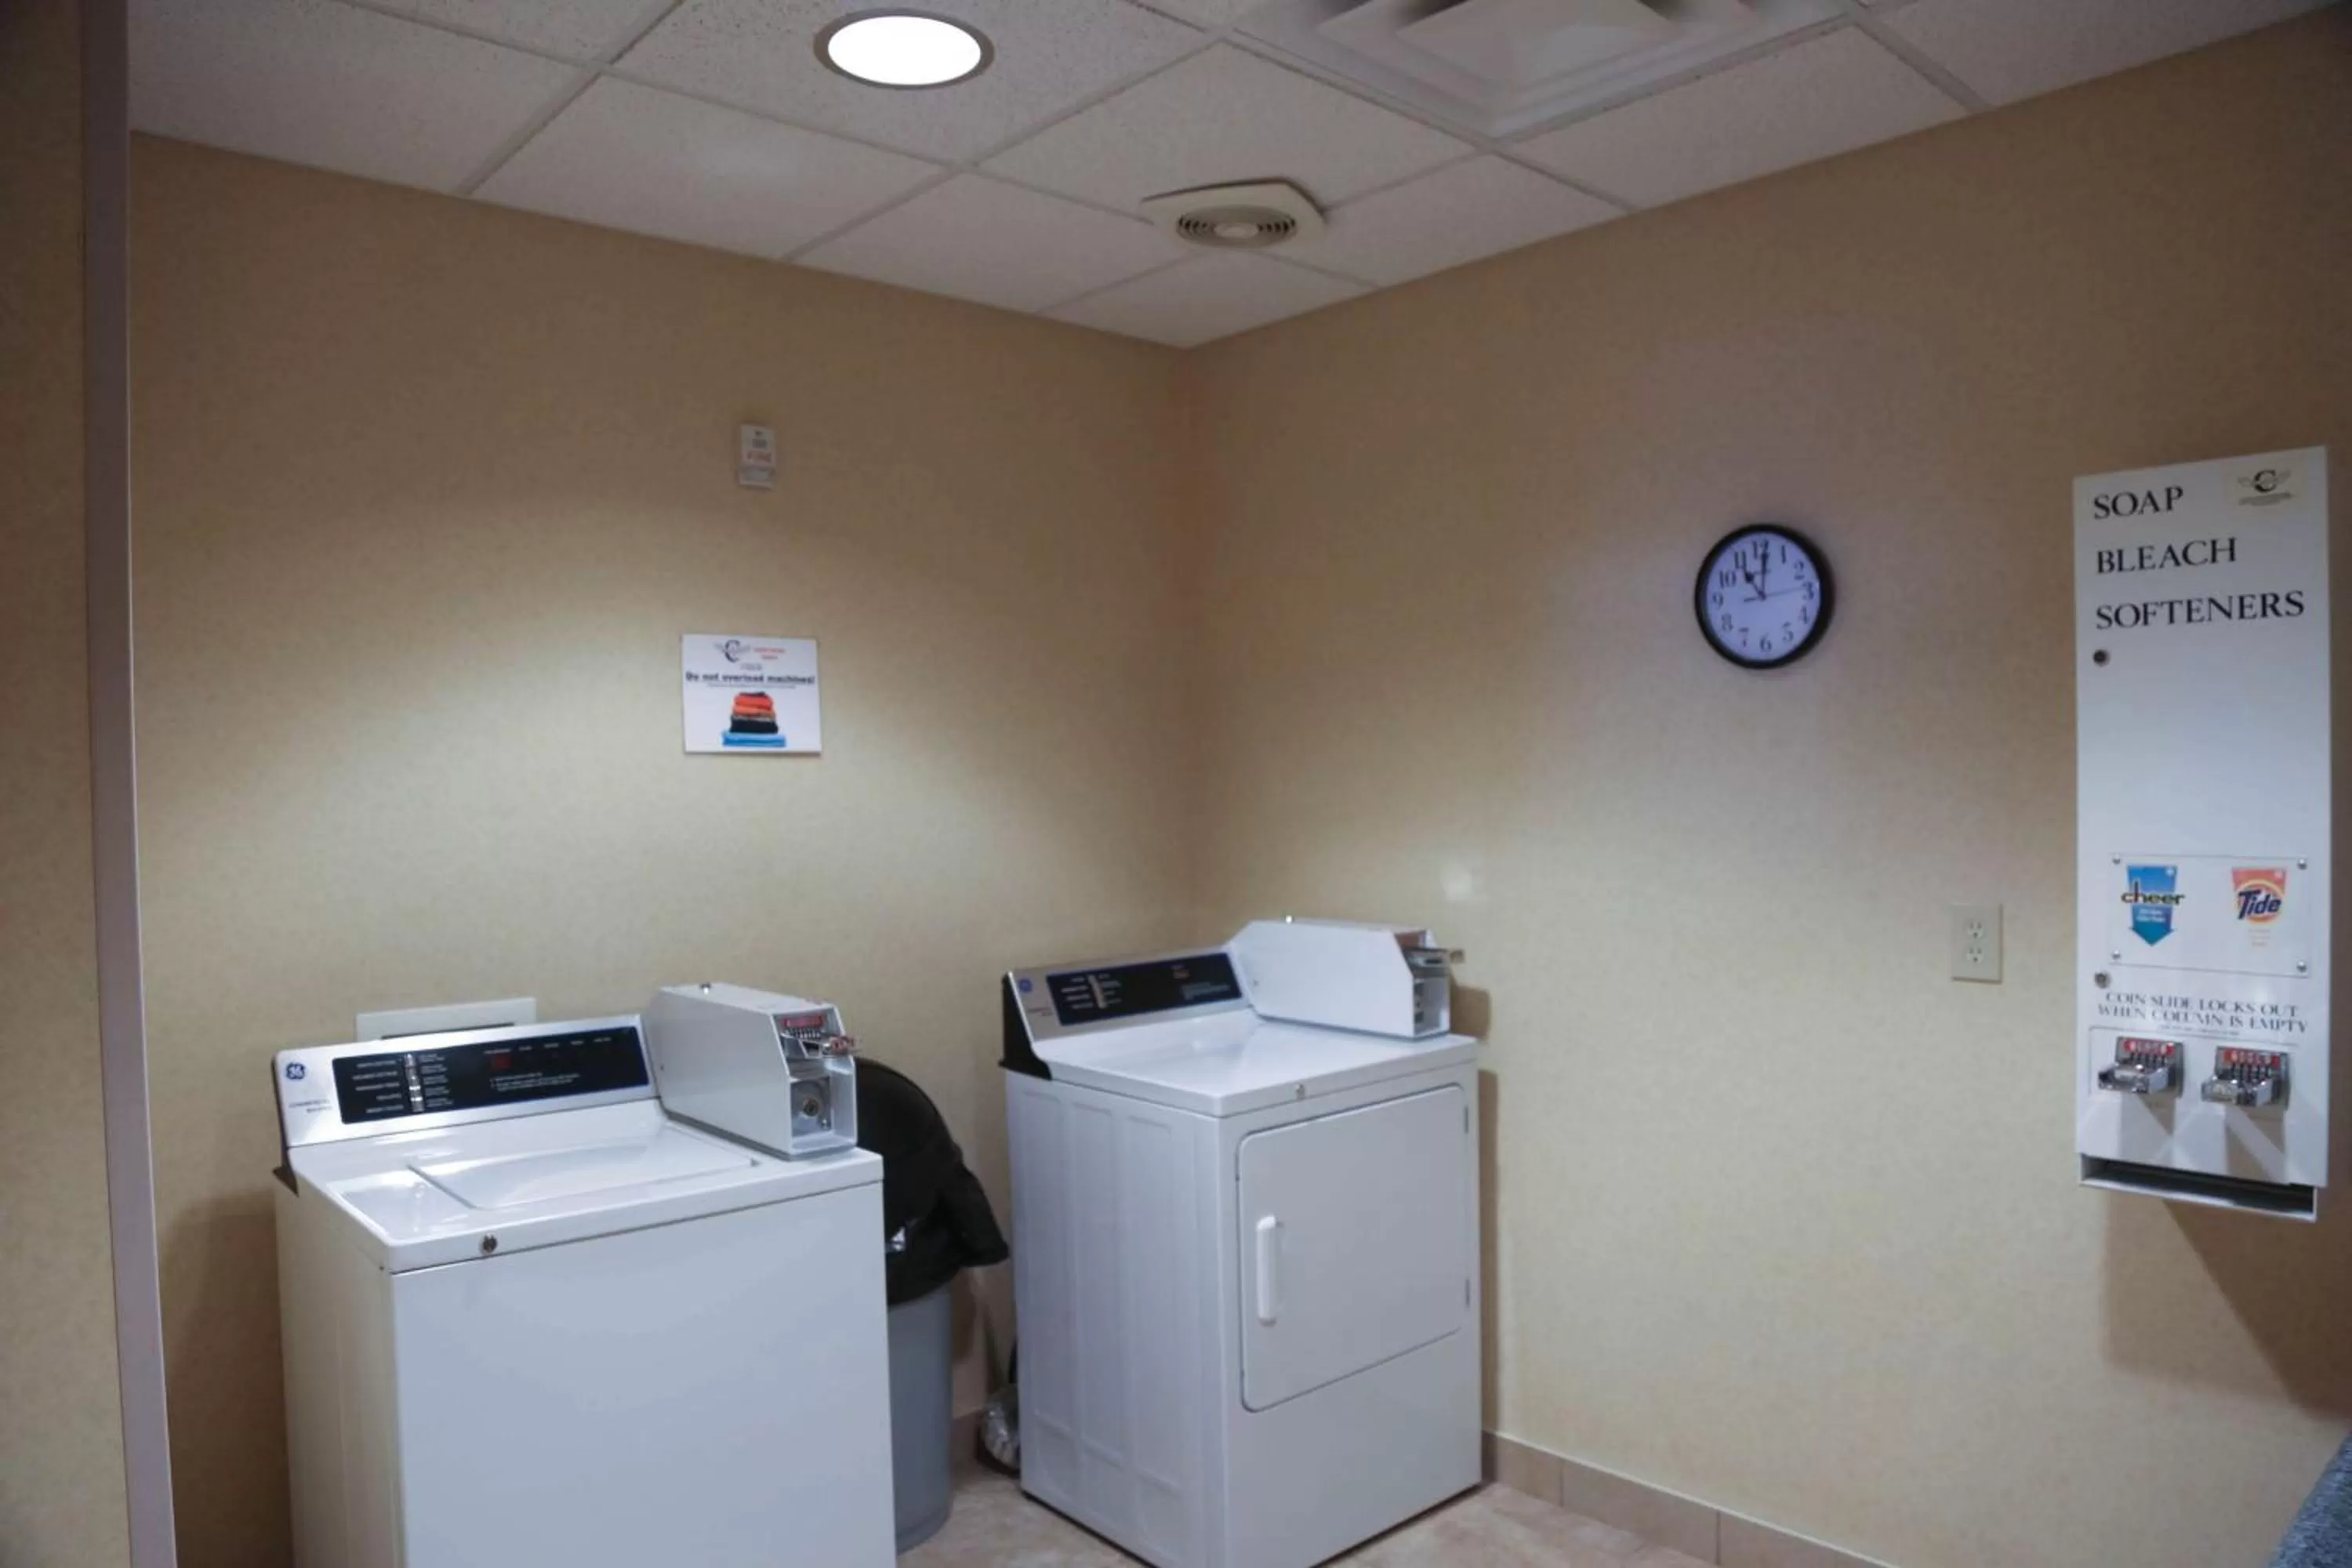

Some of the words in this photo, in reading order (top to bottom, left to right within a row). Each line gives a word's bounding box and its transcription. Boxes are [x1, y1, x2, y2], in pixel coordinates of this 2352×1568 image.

[2093, 485, 2183, 520] SOAP
[1751, 539, 1769, 559] 12
[1780, 544, 1787, 564] 1
[2096, 537, 2237, 574] BLEACH
[1719, 570, 1737, 588] 10
[1794, 561, 1805, 580] 2
[1712, 592, 1724, 609] 9
[1802, 582, 1815, 600] 3
[1798, 606, 1809, 624] 4
[2095, 590, 2305, 630] SOFTENERS
[1722, 614, 1733, 632] 8
[1782, 621, 1794, 642] 5
[1738, 627, 1749, 648] 7
[1759, 632, 1772, 652] 6
[685, 671, 699, 682] Do
[702, 672, 719, 682] not
[721, 673, 764, 684] overload
[2121, 879, 2186, 906] cheer
[2237, 889, 2282, 920] Tide
[2106, 992, 2146, 1005] COIN
[2151, 994, 2192, 1010] SLIDE
[2198, 998, 2255, 1014] LOCKS
[2261, 1003, 2299, 1017] OUT
[2098, 1004, 2146, 1020] WHEN
[2151, 1009, 2223, 1026] COLUMN
[2230, 1014, 2243, 1027] IS
[2250, 1016, 2308, 1033] EMPTY
